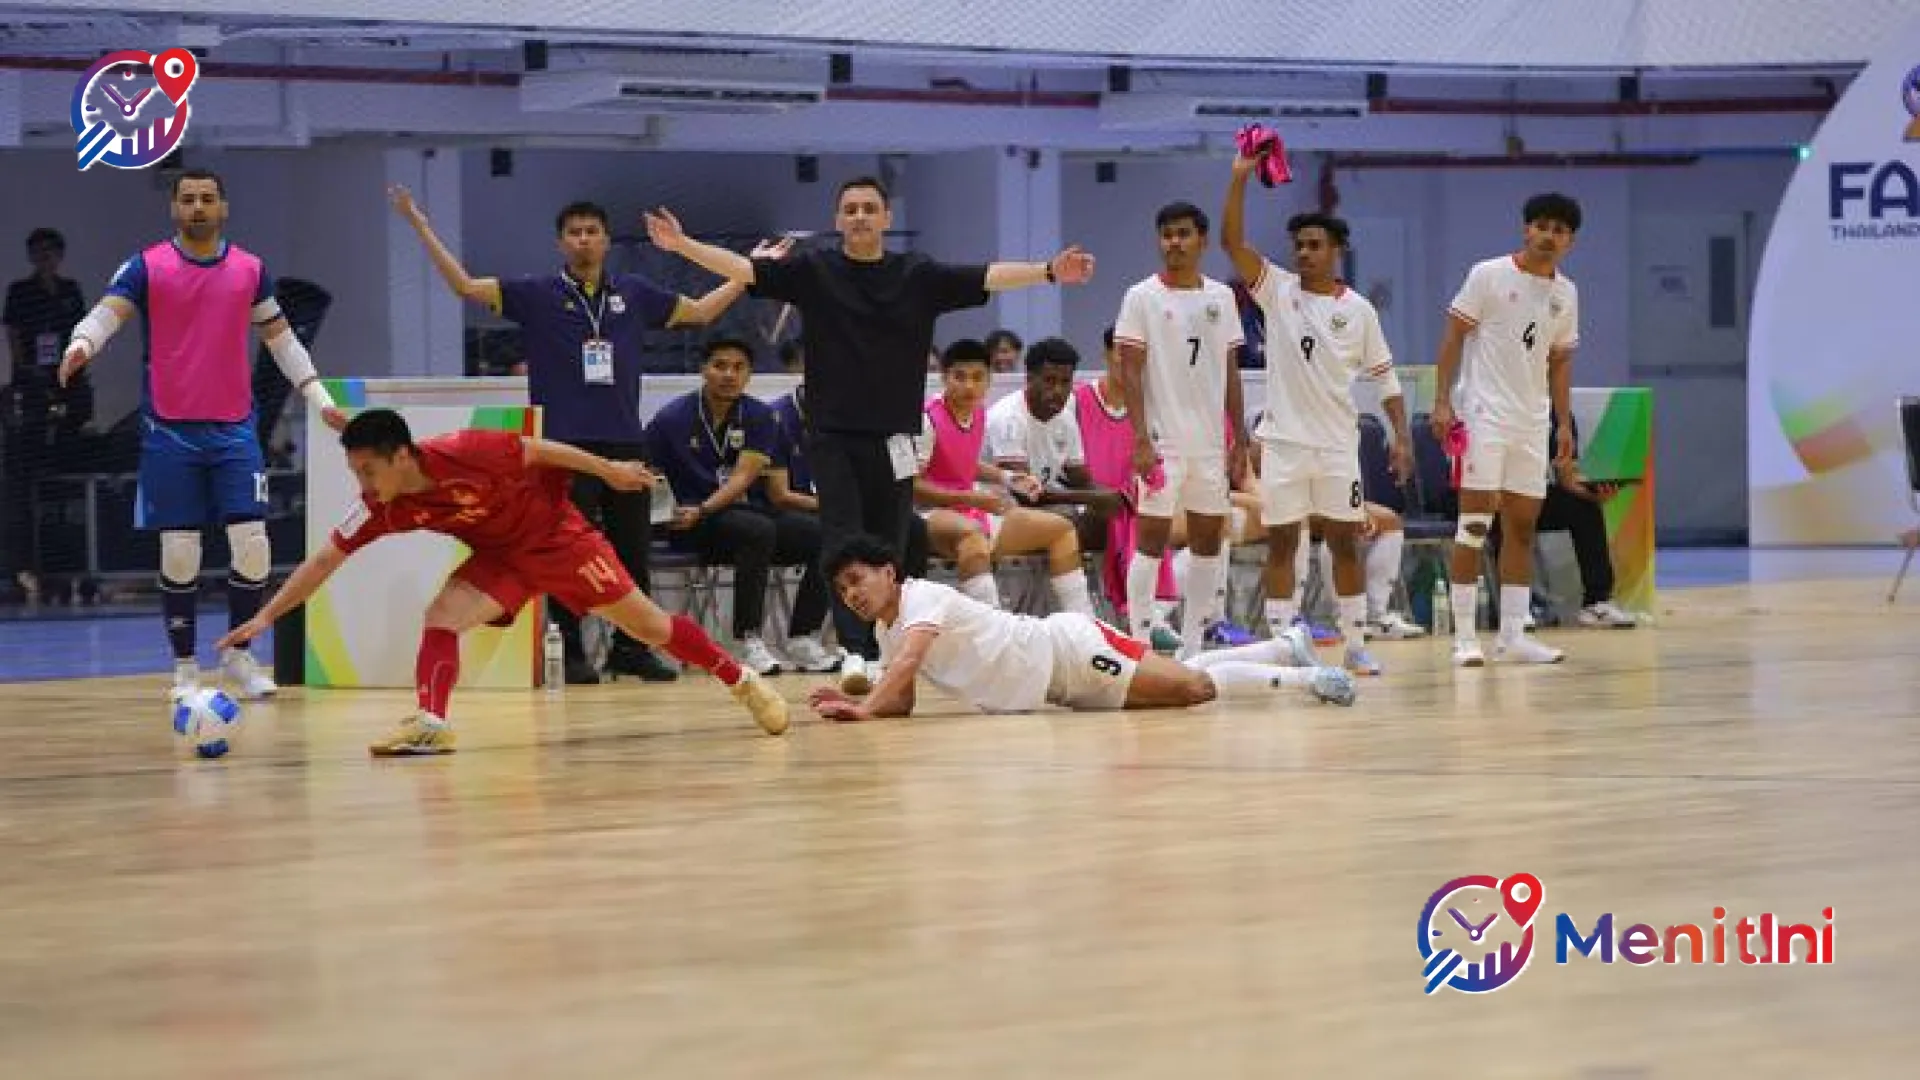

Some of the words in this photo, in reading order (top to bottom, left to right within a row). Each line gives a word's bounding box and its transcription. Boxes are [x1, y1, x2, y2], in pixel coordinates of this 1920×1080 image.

[1829, 160, 1920, 219] FA
[1301, 335, 1315, 362] 9
[1522, 321, 1535, 351] 4
[1187, 336, 1201, 367] 7
[1349, 479, 1362, 508] 8
[576, 556, 620, 593] 14
[1092, 655, 1121, 676] 9
